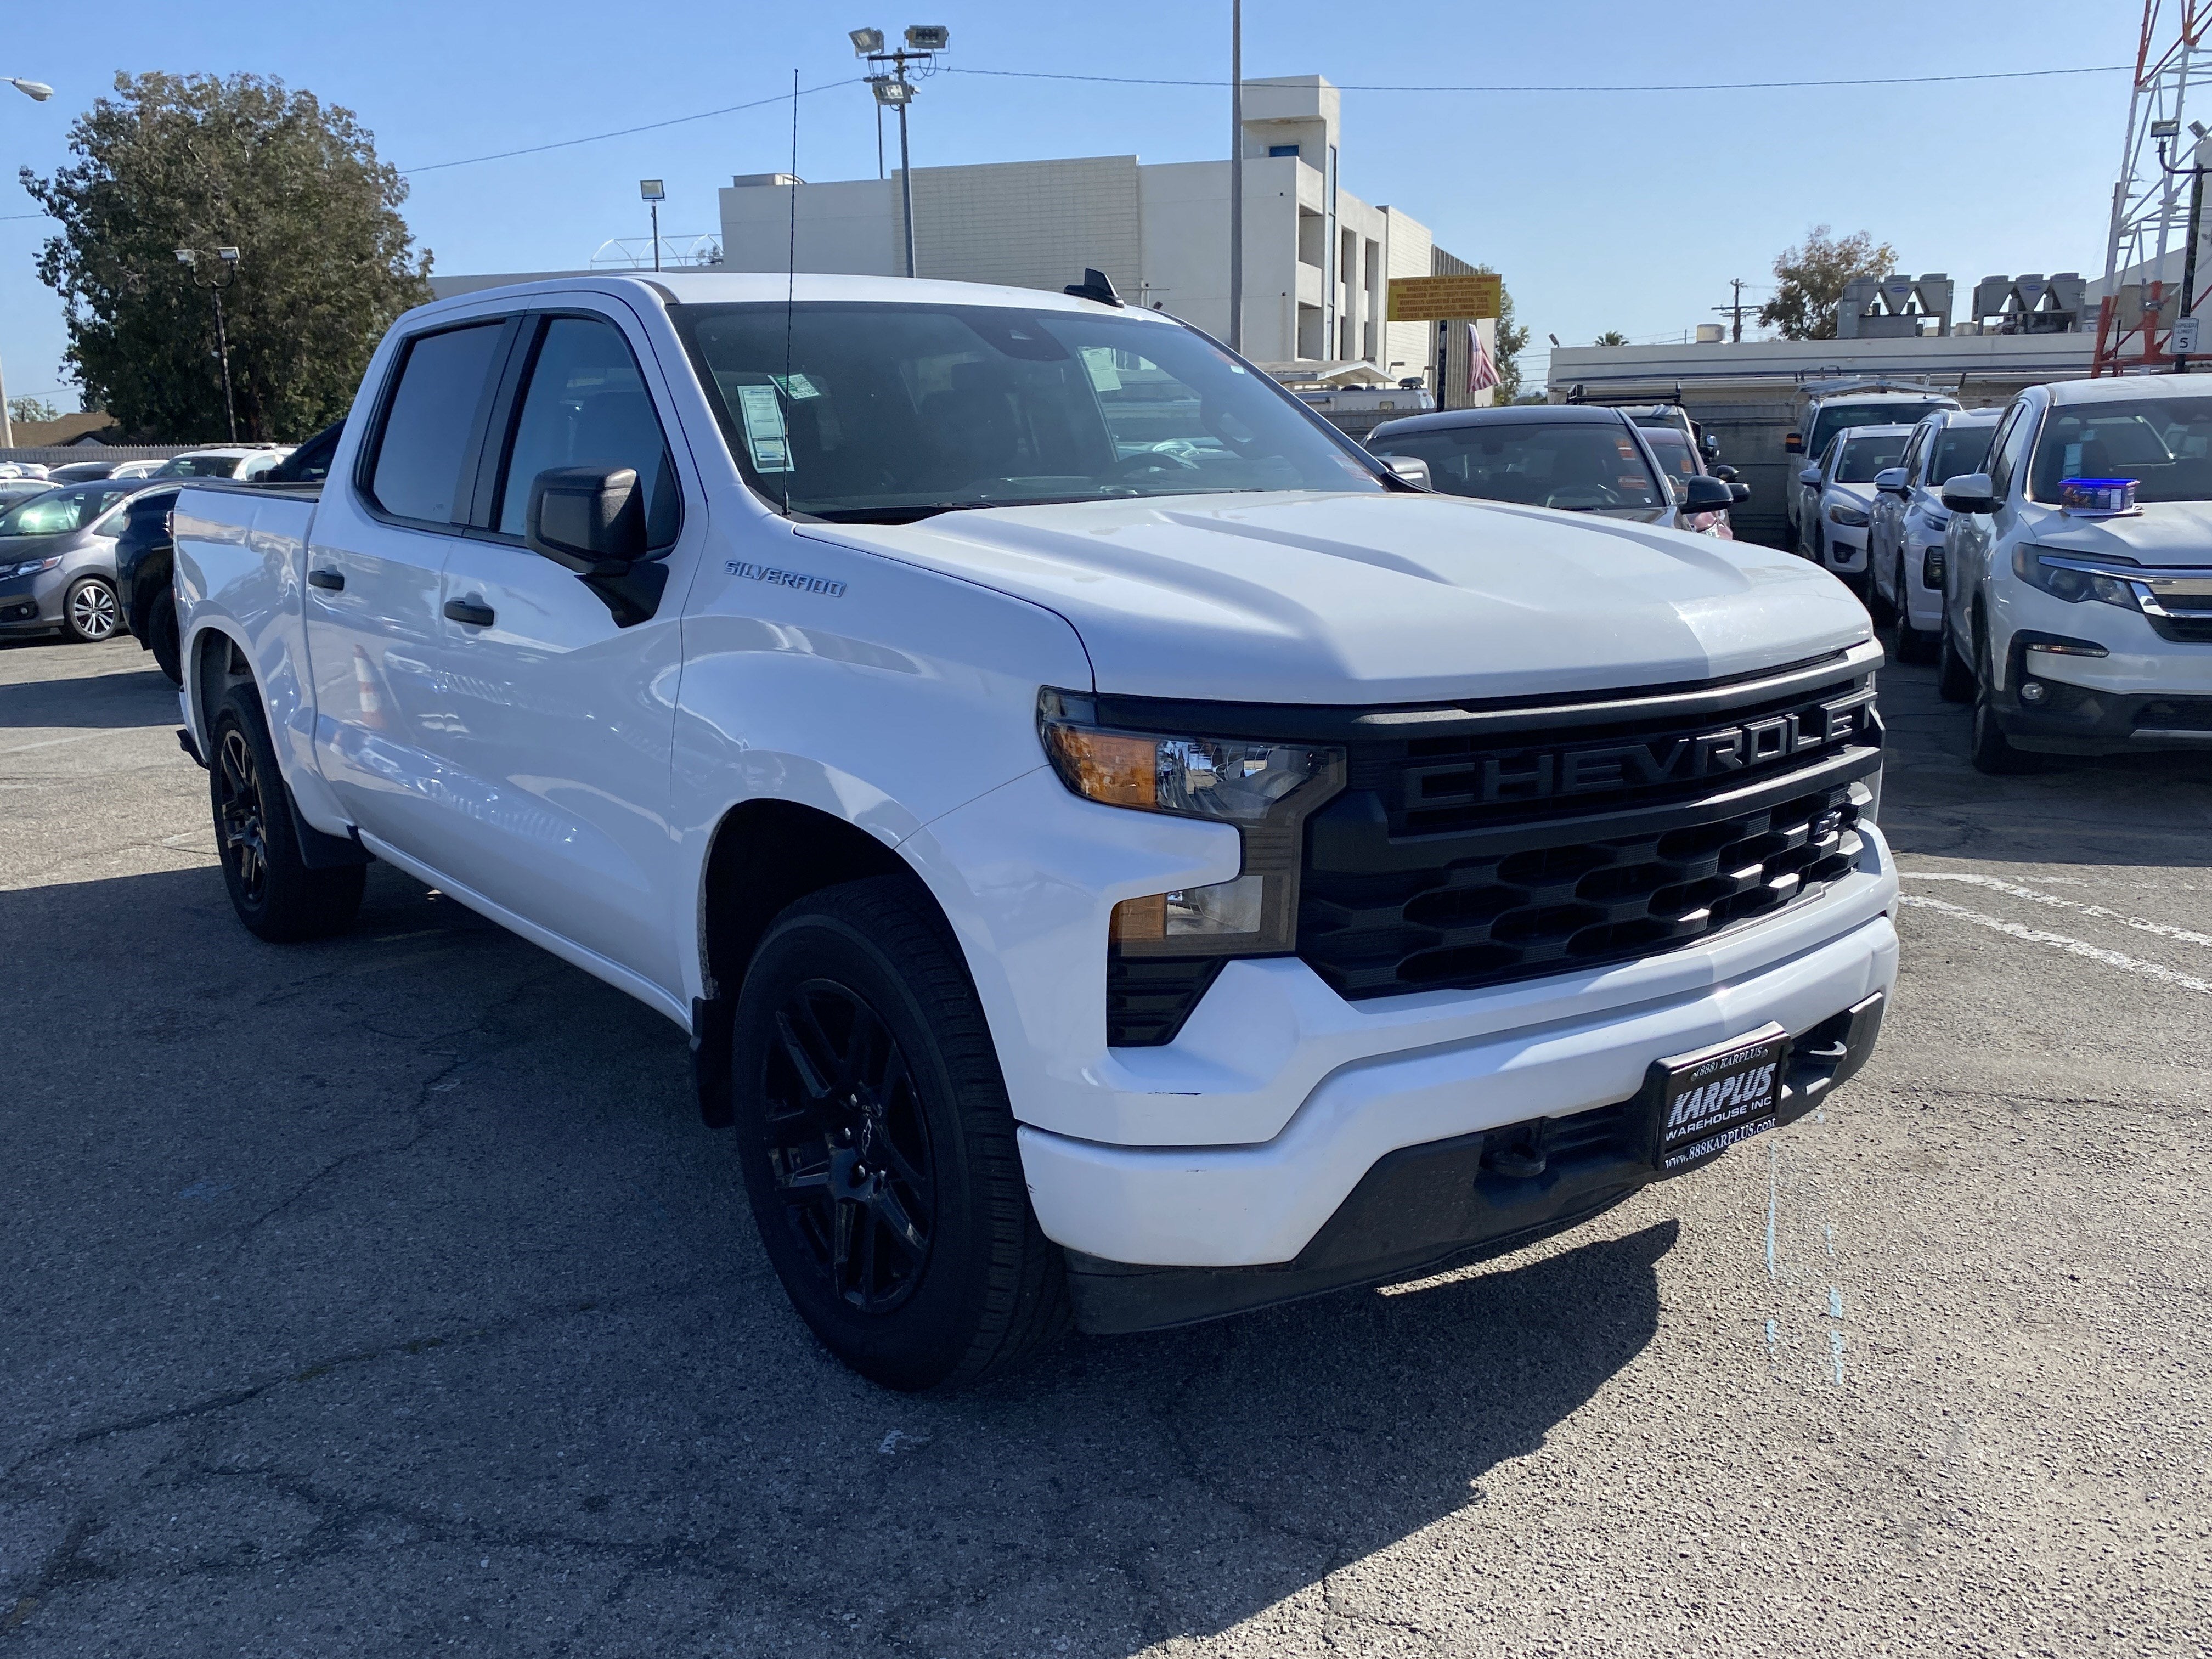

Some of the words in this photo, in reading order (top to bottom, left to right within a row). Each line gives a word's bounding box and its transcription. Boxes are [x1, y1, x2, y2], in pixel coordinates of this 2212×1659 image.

[2179, 337, 2188, 348] 5
[724, 560, 847, 597] SILVERADO
[1402, 692, 1878, 810] CHEVROLET
[1696, 1061, 1718, 1077] (888)
[1719, 1046, 1763, 1069] KARPLUS
[1667, 1062, 1777, 1128] KARPLUS
[1665, 1104, 1747, 1141] WAREHOUSE
[1751, 1096, 1772, 1110] INC
